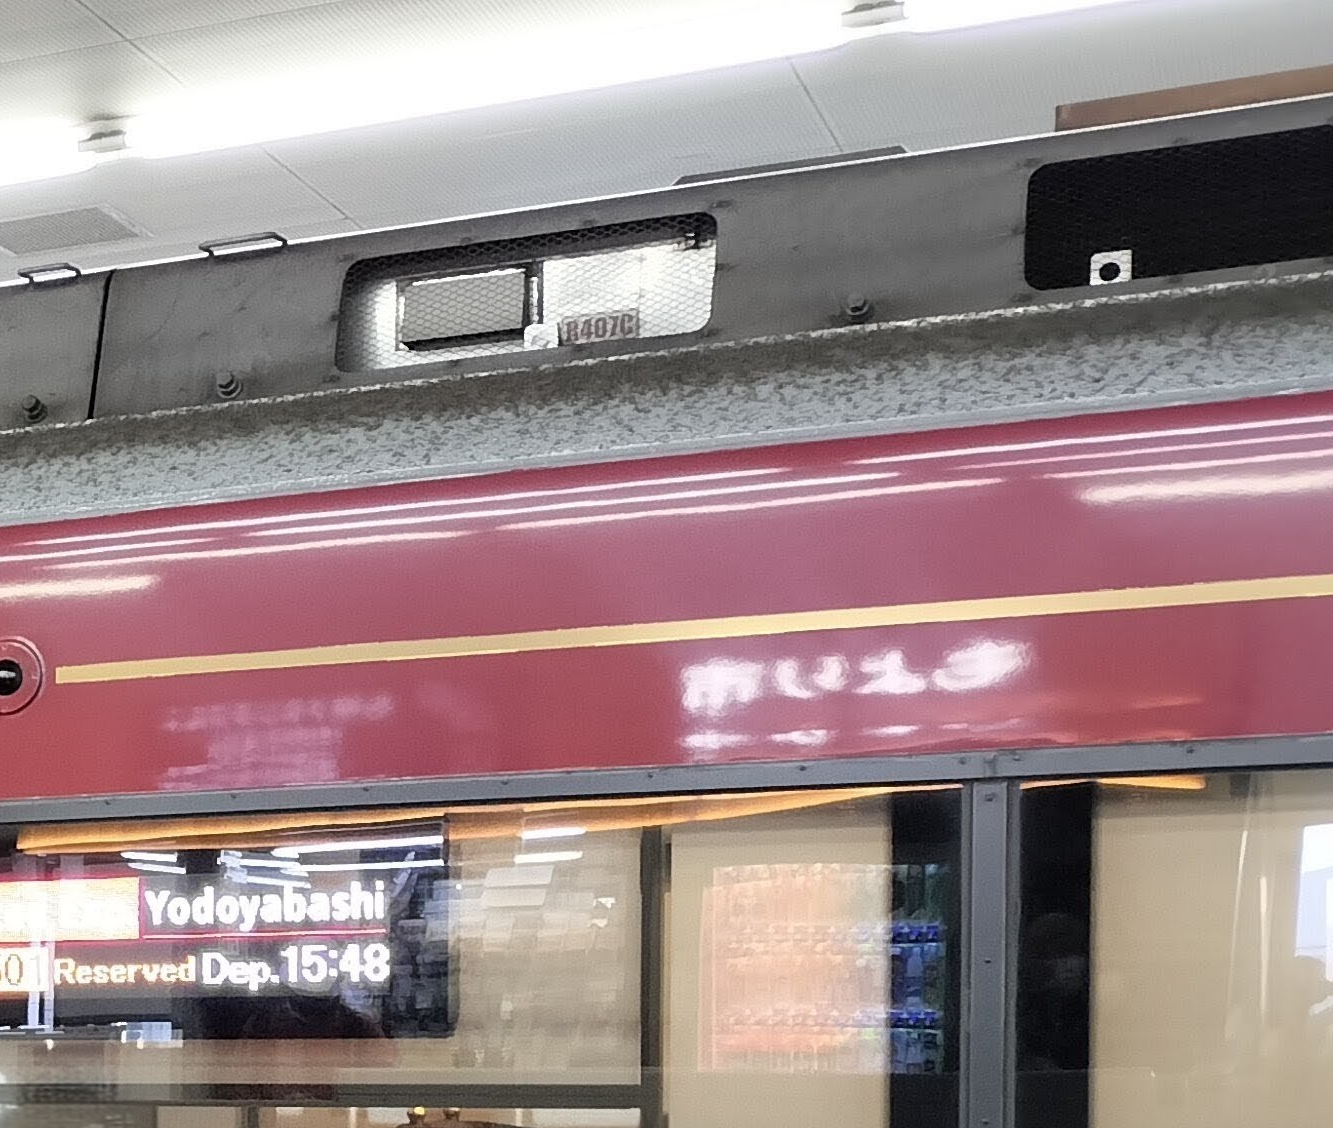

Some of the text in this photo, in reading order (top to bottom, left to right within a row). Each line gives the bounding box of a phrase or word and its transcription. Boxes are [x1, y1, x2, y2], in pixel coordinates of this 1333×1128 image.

[565, 313, 634, 342] R407C
[144, 880, 386, 932] Yodoyabashi
[53, 955, 196, 986] Reserved
